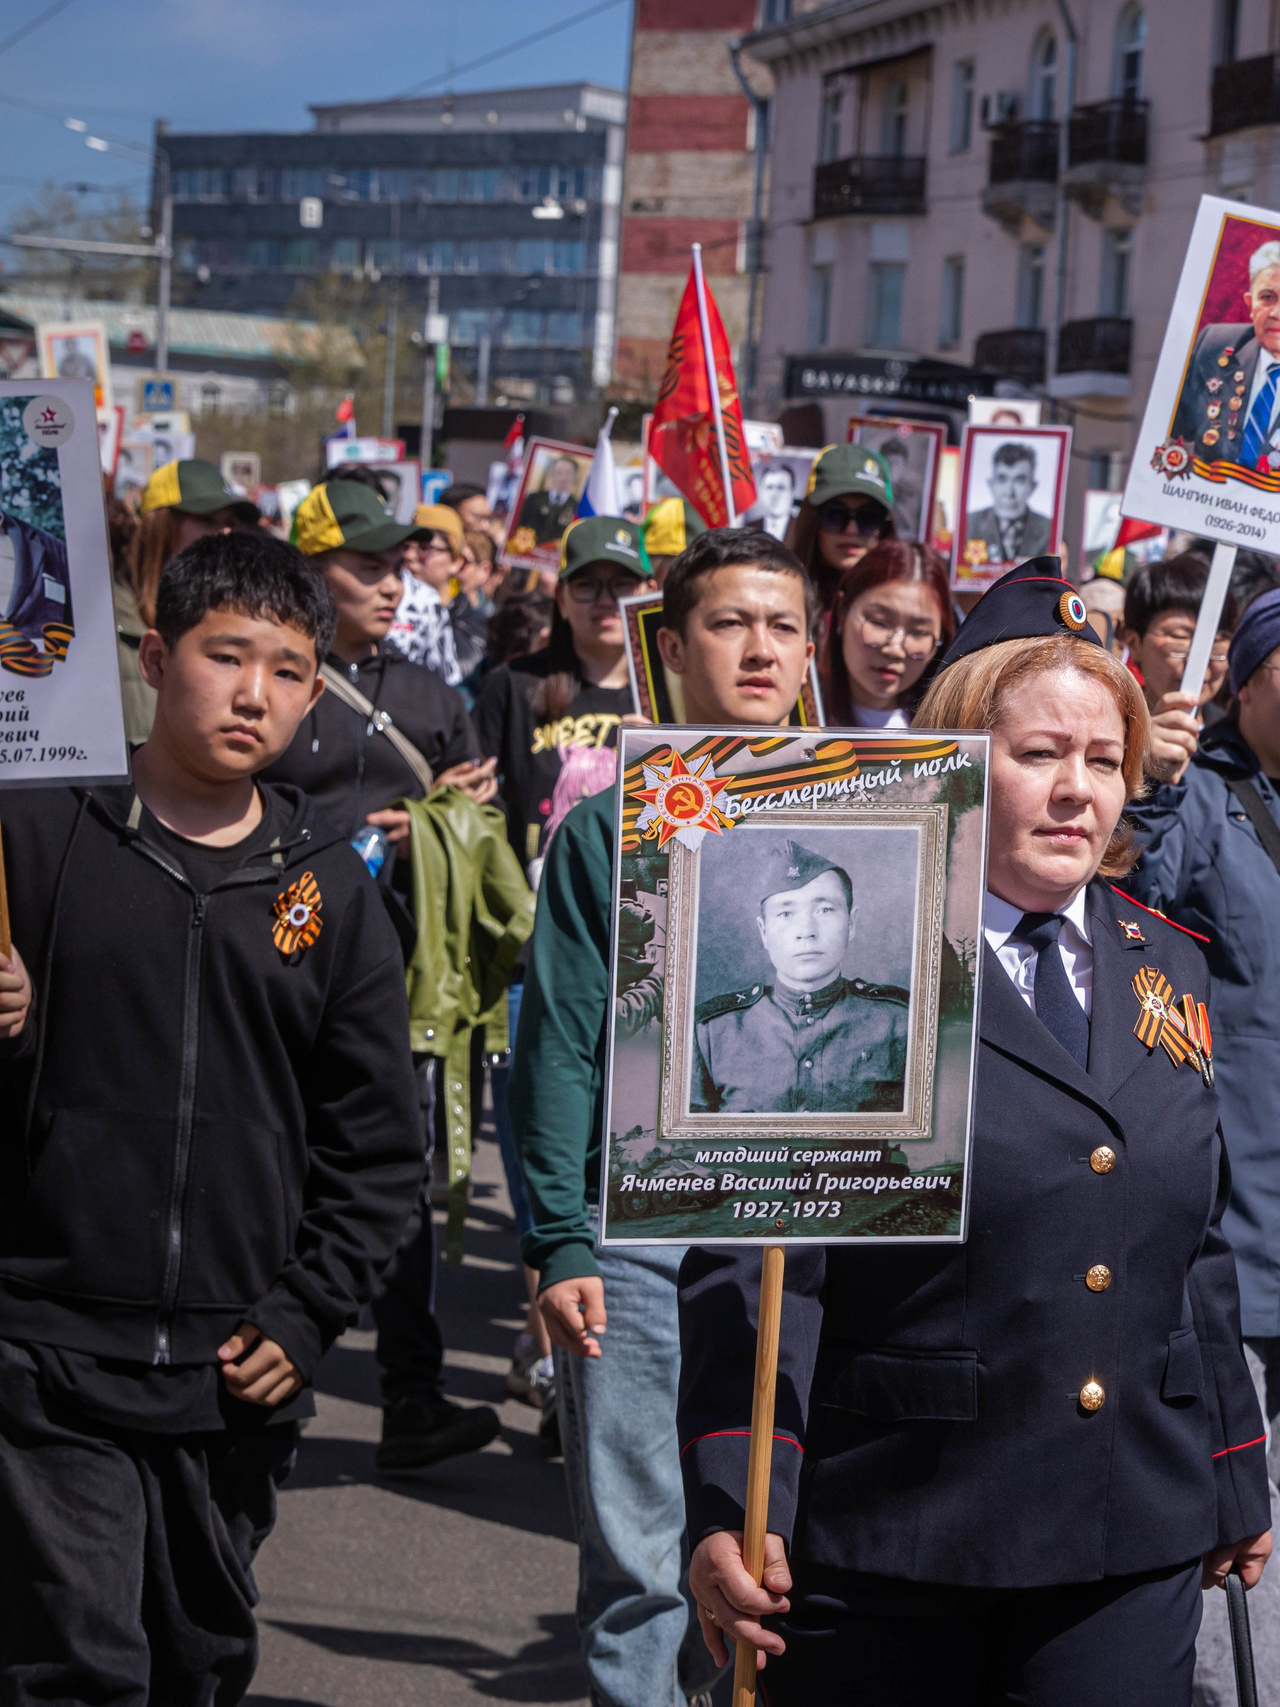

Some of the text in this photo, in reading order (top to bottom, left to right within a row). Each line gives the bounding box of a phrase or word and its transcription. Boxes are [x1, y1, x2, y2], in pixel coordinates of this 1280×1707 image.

[1162, 483, 1214, 506] ШАНГИН
[1215, 496, 1249, 515] ИВАН
[1205, 514, 1266, 540] (1926-2014)
[725, 751, 972, 819] Бессмертный полк
[658, 776, 705, 823] ОТЕЧЕСТВЕННАЯ
[694, 1146, 882, 1166] младший сержант
[619, 1171, 951, 1194] Ячменев Василий Григорьевич
[732, 1201, 841, 1218] 1927-1973
